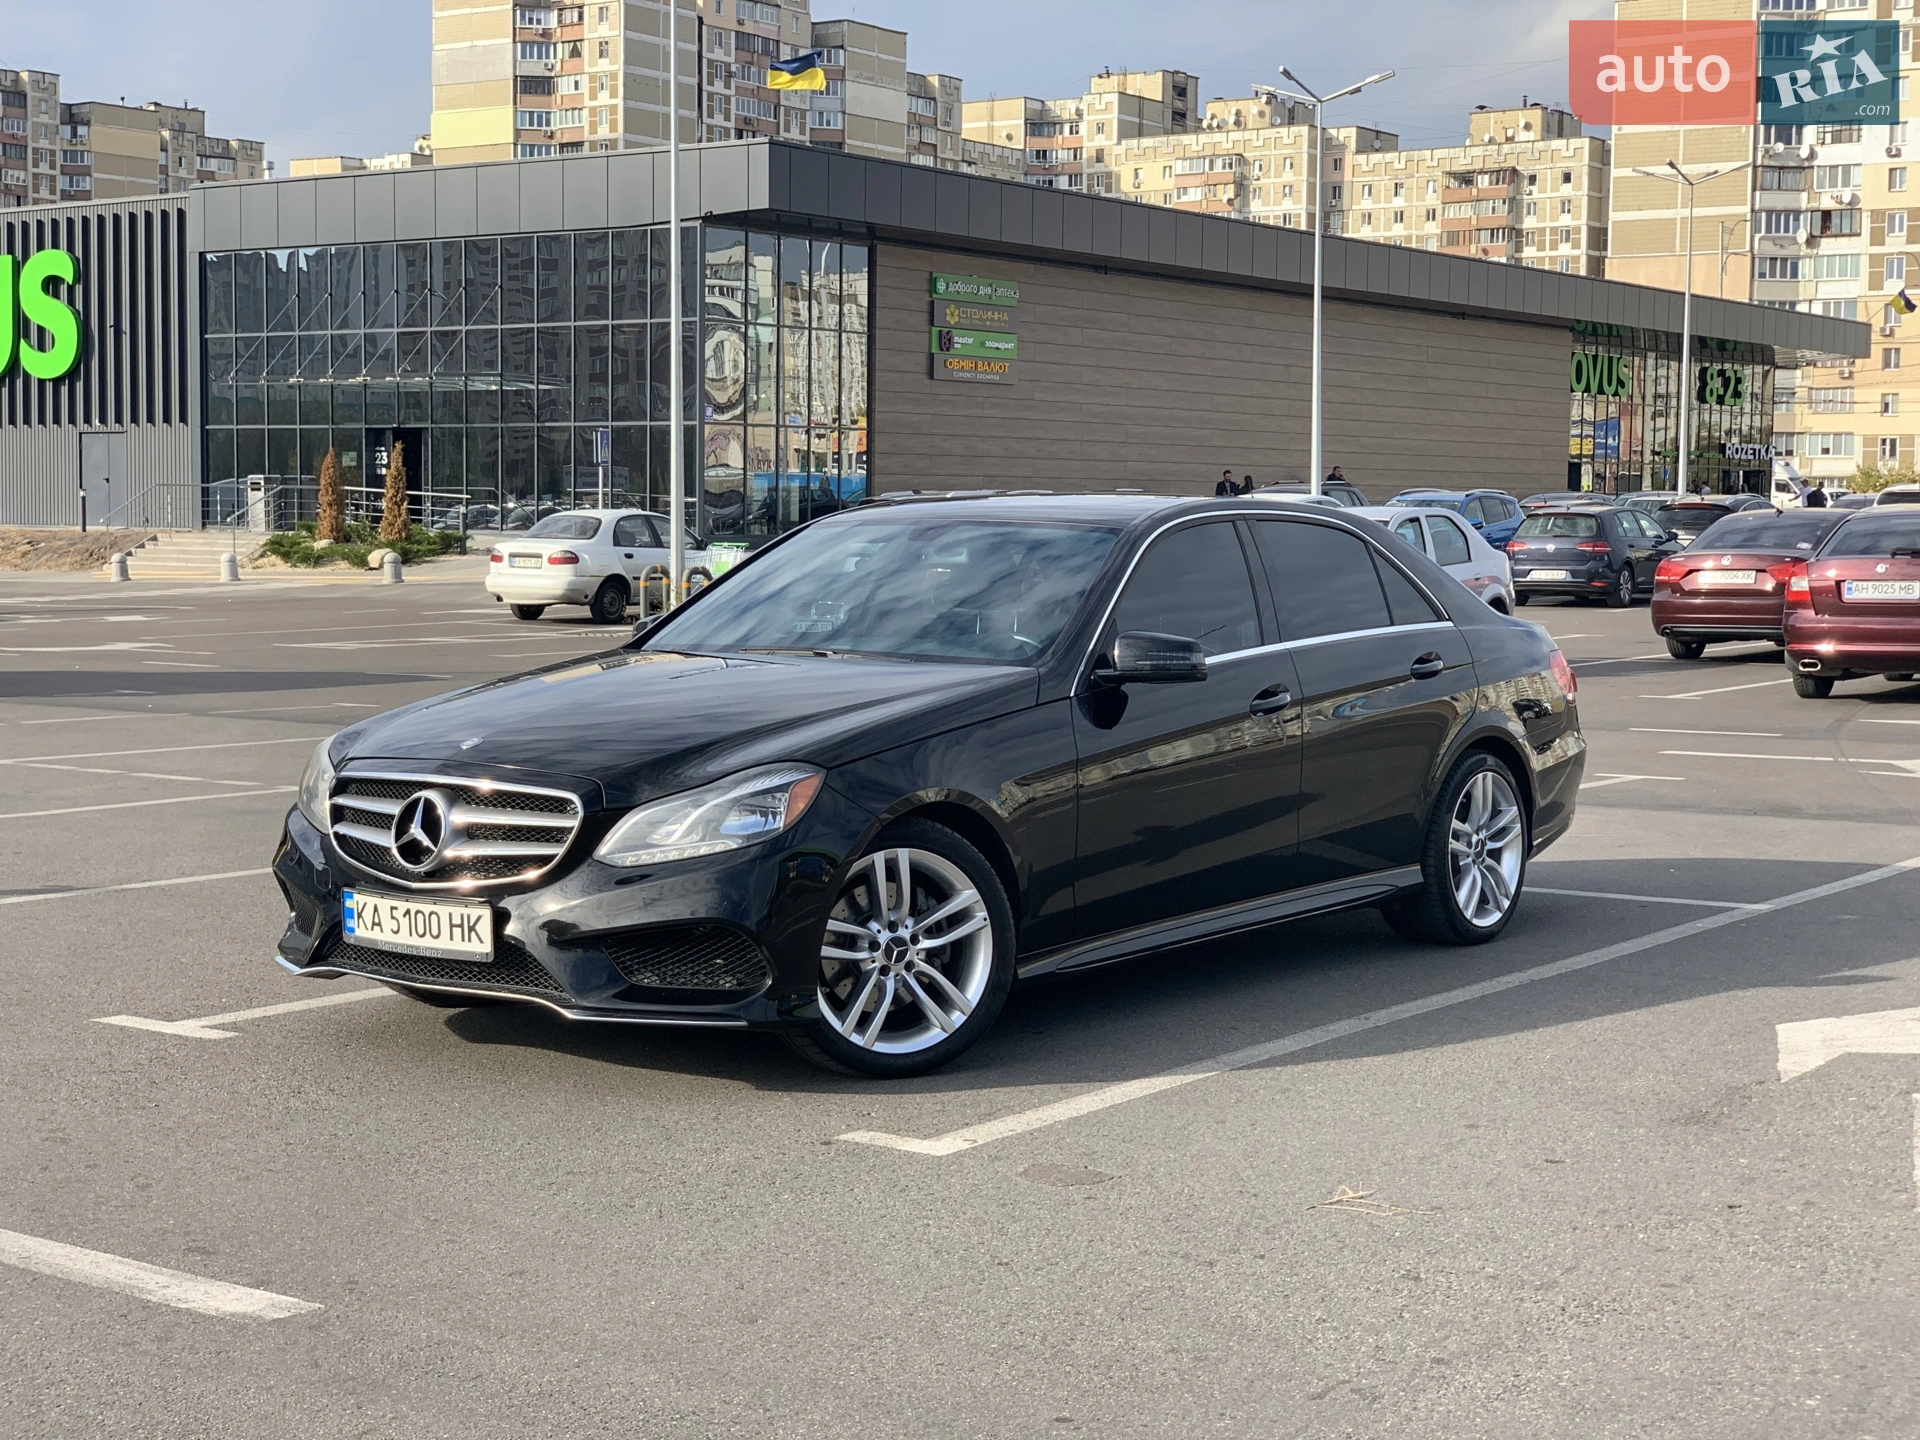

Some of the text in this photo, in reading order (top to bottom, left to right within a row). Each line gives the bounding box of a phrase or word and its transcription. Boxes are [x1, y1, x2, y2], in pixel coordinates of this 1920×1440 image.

[948, 281, 1020, 299] доброго дня аптека
[0, 249, 79, 379] S
[960, 307, 1009, 321] СТОЛИЧНА
[954, 336, 974, 344] master
[946, 358, 1010, 373] ОБМІН ВАЛЮТ
[953, 371, 1000, 381] CURRENCY EXCHANGE
[1705, 366, 1746, 407] 8-23
[375, 452, 389, 465] 23
[1725, 443, 1775, 460] ROZETKA
[1720, 571, 1740, 580] 7004
[1740, 571, 1754, 581] XK
[1853, 583, 1915, 595] AH 9025 MB
[356, 900, 485, 945] KA 5100 HK
[377, 940, 443, 958] Mercedes-Benz
